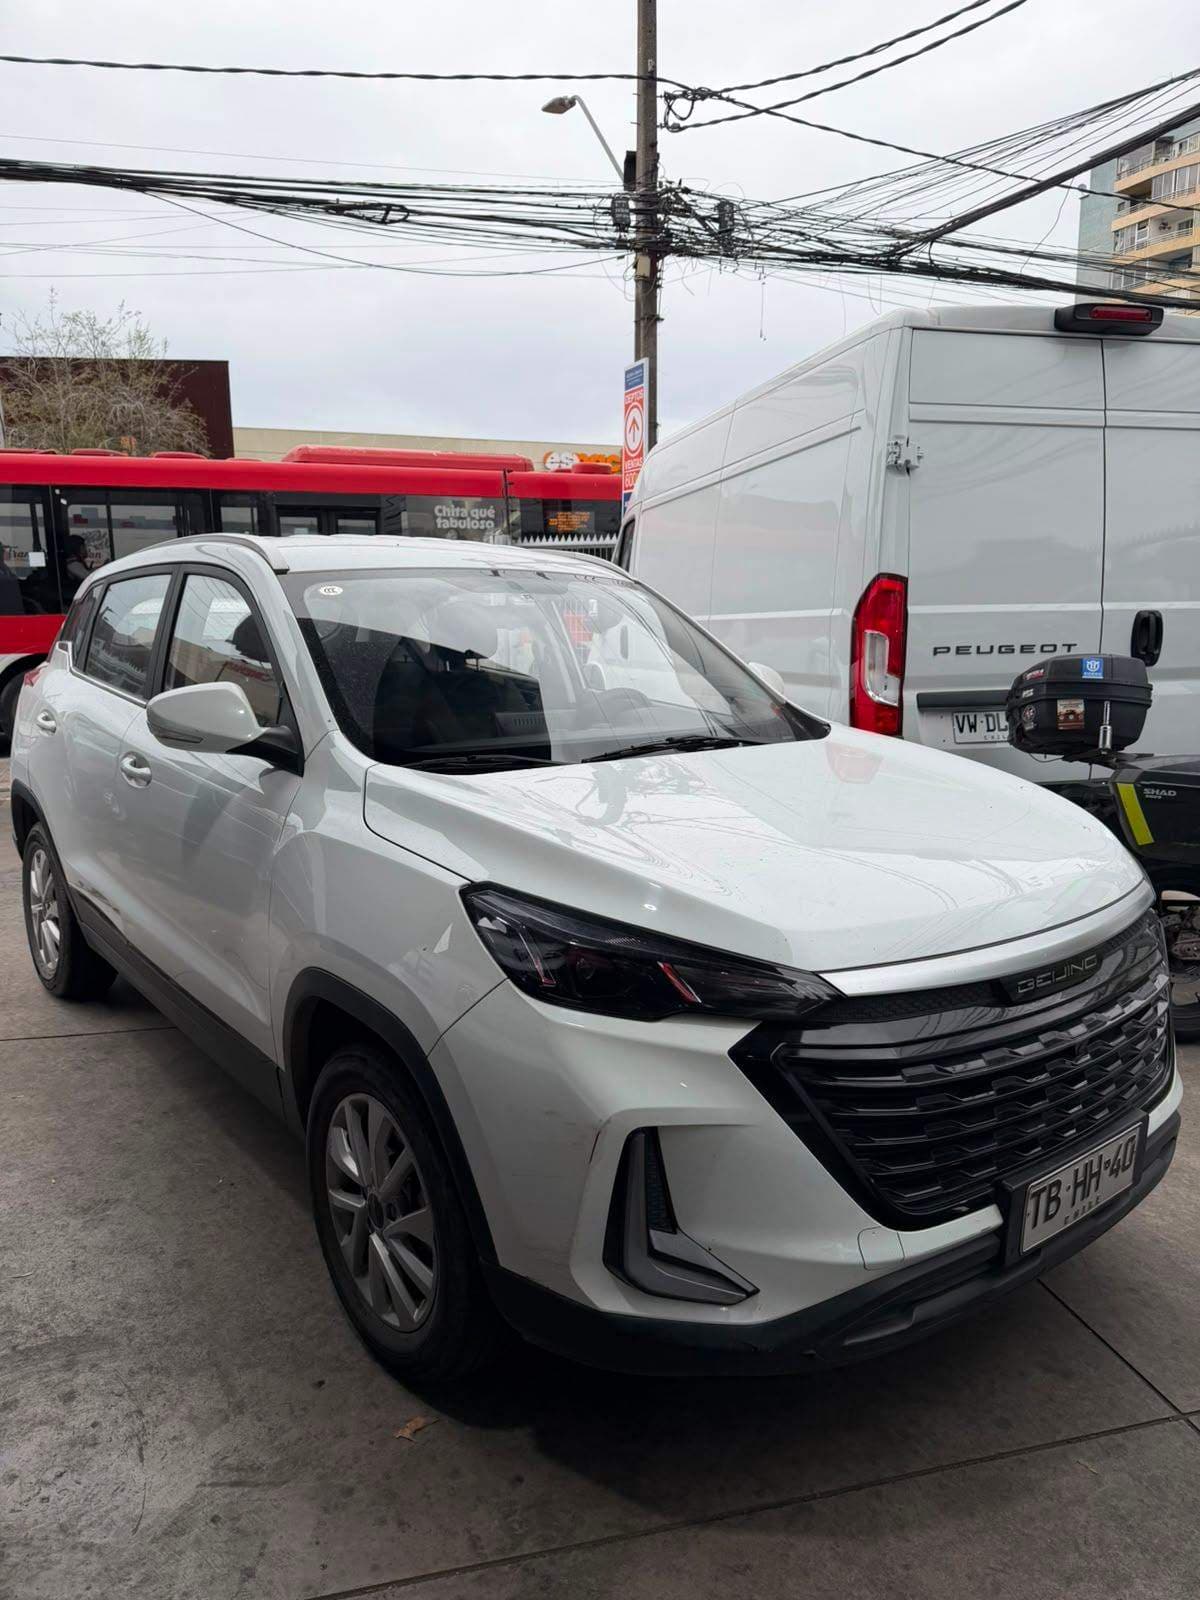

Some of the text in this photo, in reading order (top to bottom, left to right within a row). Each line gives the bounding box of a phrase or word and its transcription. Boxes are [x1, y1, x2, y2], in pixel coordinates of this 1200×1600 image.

[434, 505, 496, 519] Chita qué
[436, 516, 495, 530] fabuloso
[933, 643, 1078, 656] PEUGEOT
[1143, 788, 1177, 797] SHAD
